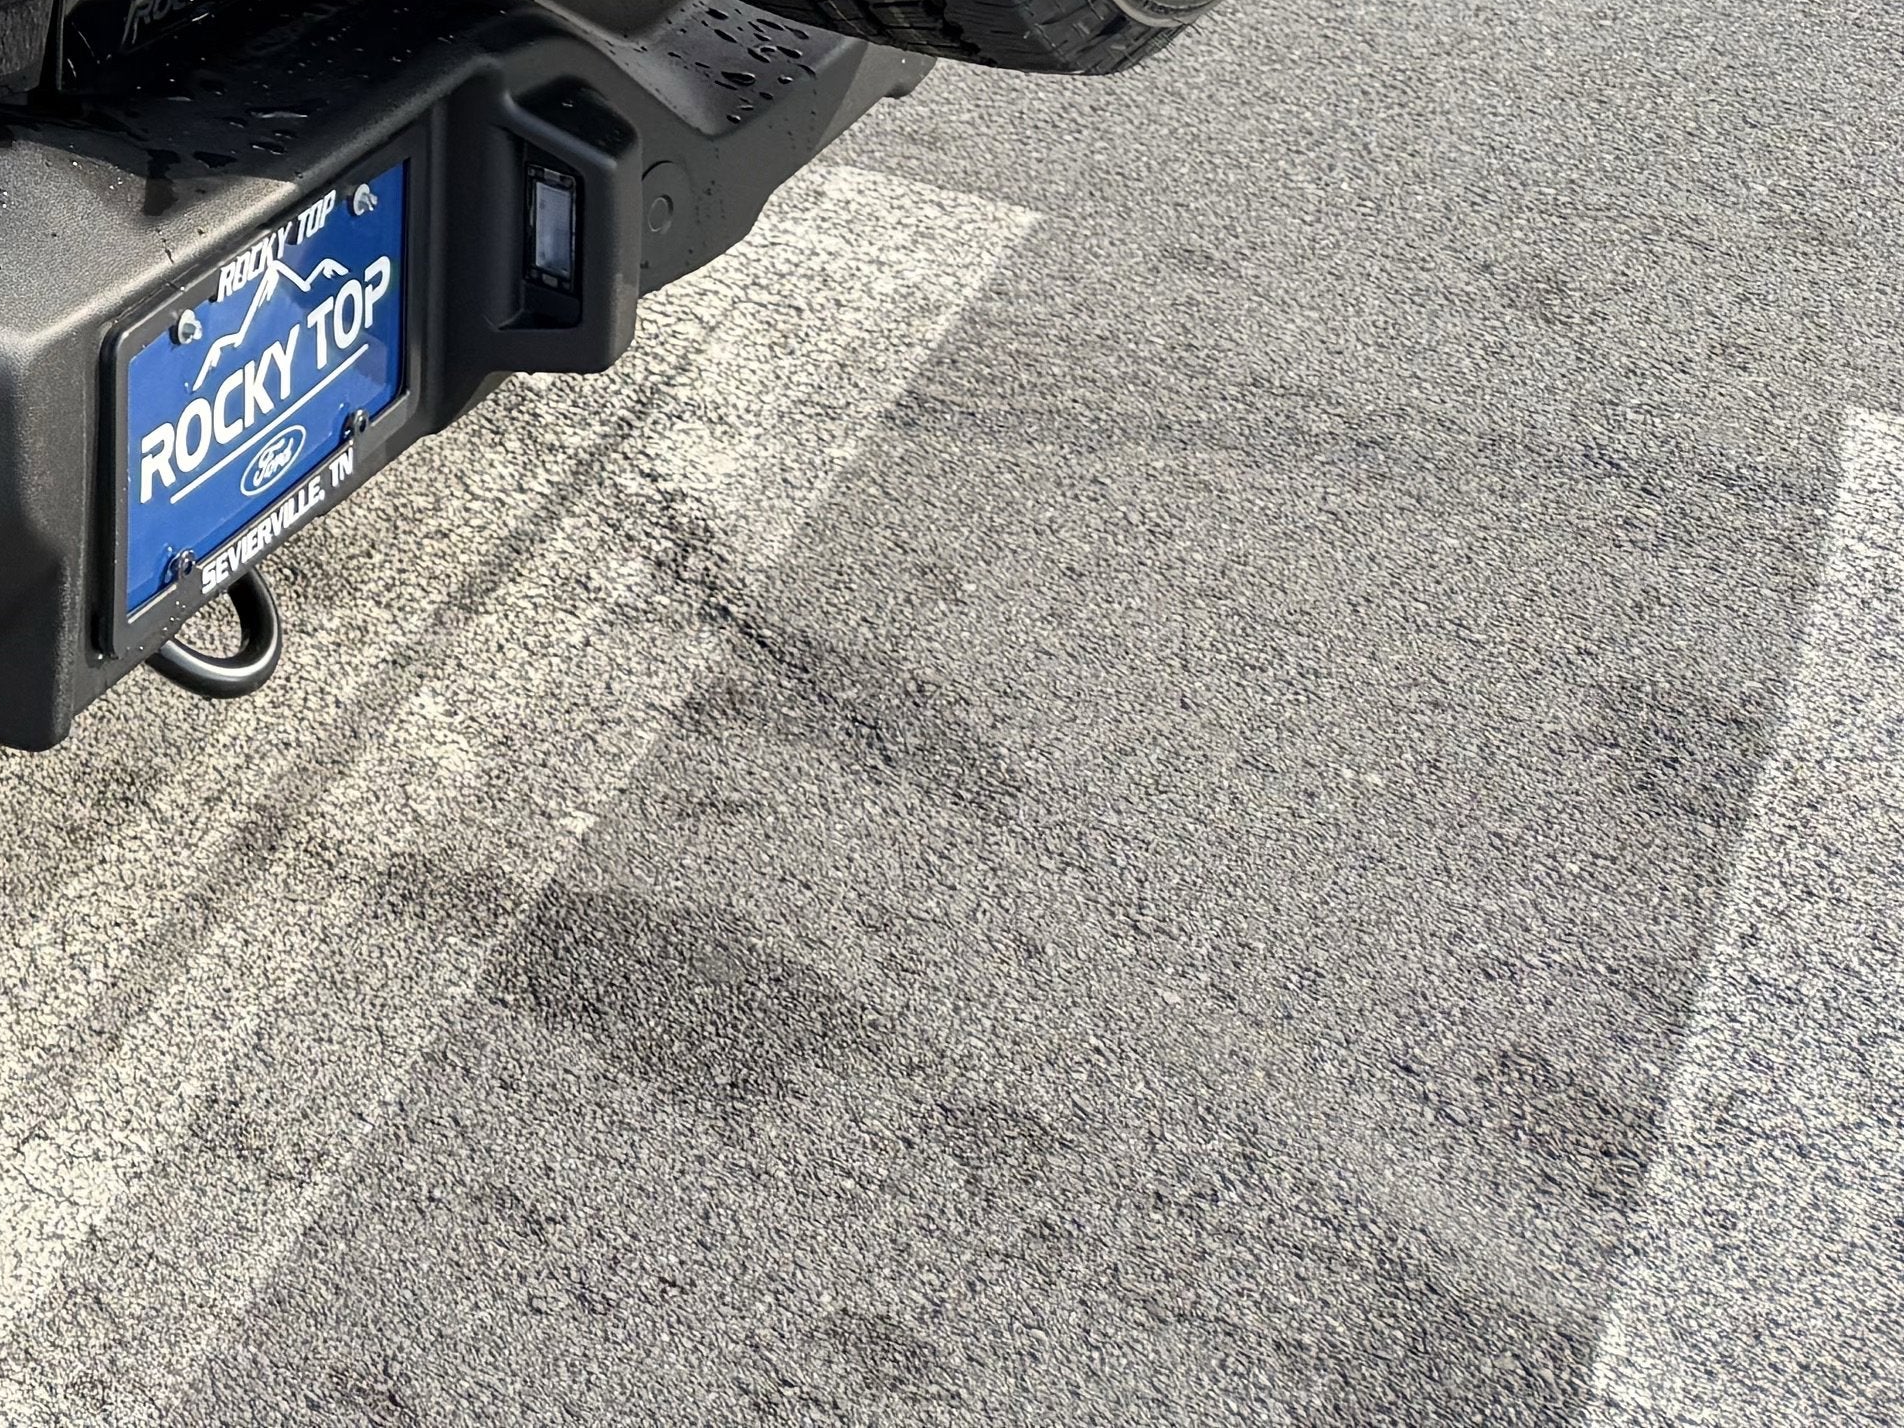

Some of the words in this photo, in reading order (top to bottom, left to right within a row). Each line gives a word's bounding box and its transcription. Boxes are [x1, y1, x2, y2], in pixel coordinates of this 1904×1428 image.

[216, 220, 293, 303] ROCKY
[296, 189, 337, 245] TOP
[139, 338, 295, 504] ROCKY
[306, 255, 391, 371] TOP
[202, 475, 326, 594] SEVIERVILLE,
[329, 447, 354, 488] TN
[252, 437, 294, 488] Ford
